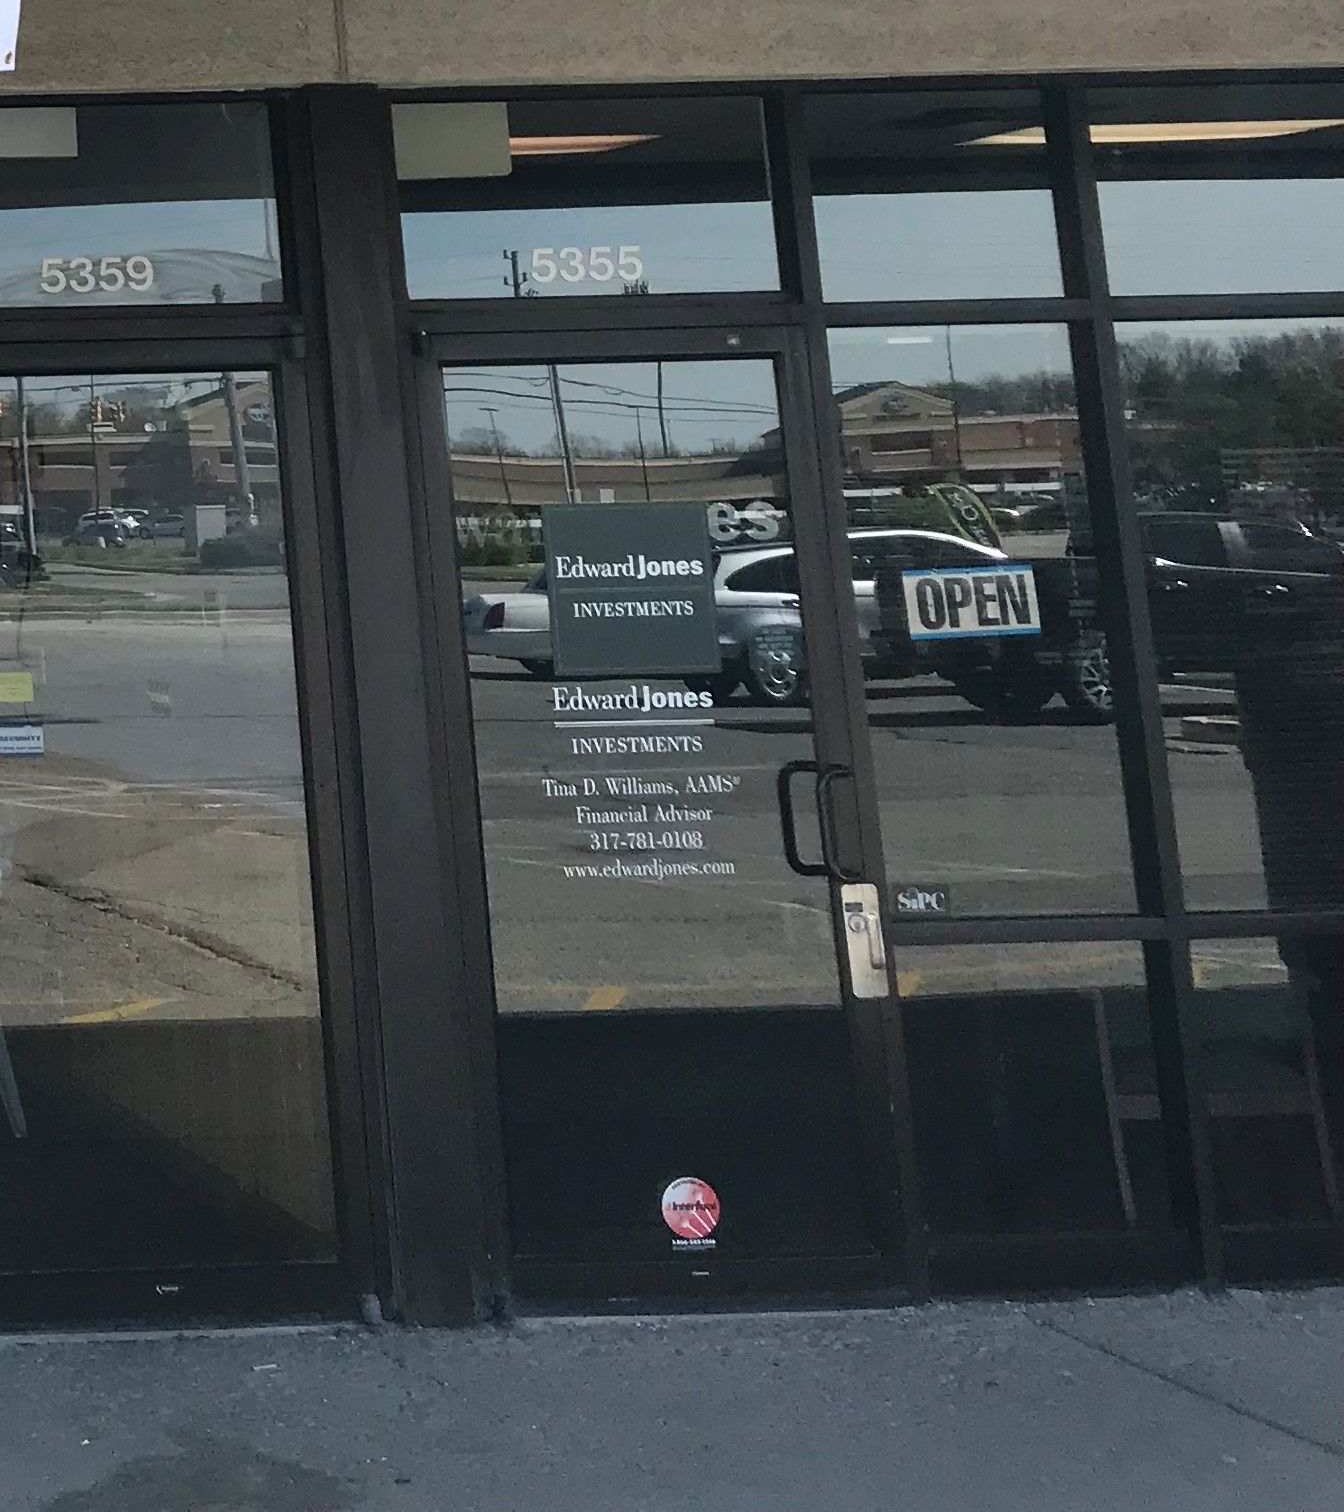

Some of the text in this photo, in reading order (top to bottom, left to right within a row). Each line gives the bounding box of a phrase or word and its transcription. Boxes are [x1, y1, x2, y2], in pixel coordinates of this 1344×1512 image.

[39, 255, 155, 294] 5359
[529, 244, 644, 284] 5355
[573, 600, 695, 618] INVESTMENTS
[915, 573, 1032, 630] OPEN
[571, 735, 704, 754] INVESTMENTS
[541, 778, 578, 797] Tina
[583, 778, 600, 796] D.
[575, 803, 714, 824] Financial Advisor
[589, 830, 704, 851] 317-781-0108
[562, 857, 736, 881] www.edwardjones.com
